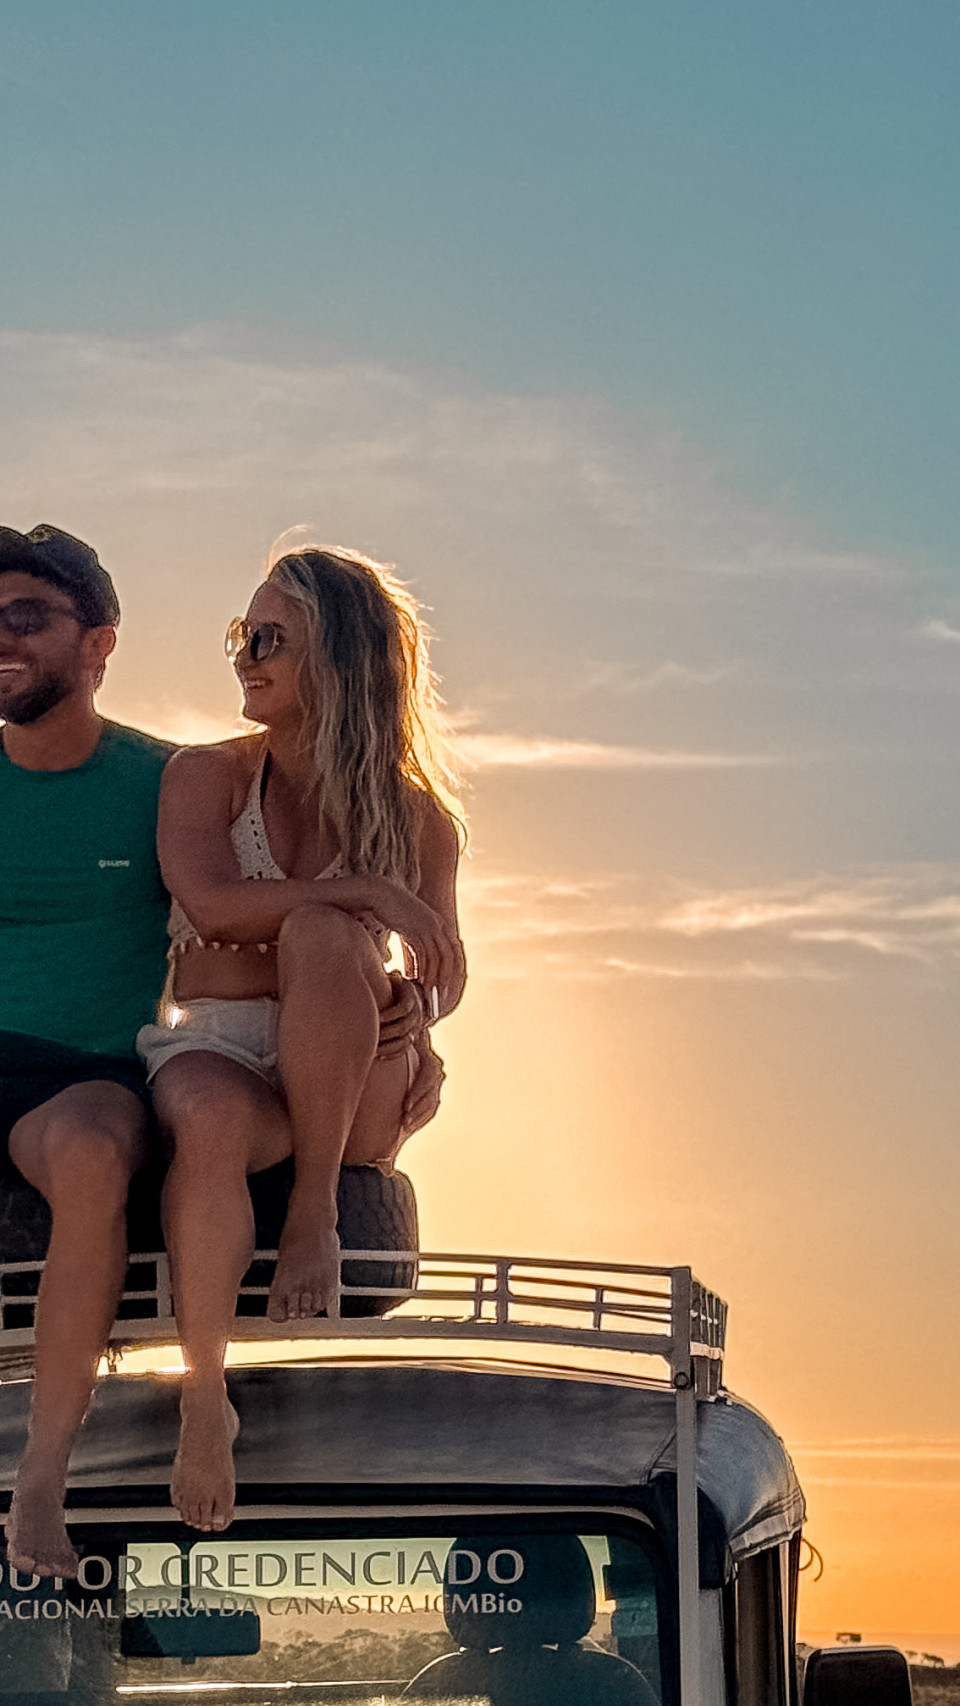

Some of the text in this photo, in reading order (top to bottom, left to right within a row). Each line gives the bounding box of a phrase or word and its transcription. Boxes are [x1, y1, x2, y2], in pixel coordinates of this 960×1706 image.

[160, 1549, 524, 1588] CREDENCIADO
[126, 1596, 213, 1618] SERRA
[219, 1597, 259, 1617] DA
[266, 1595, 416, 1616] CANASTRA
[424, 1592, 523, 1615] ICMBio
